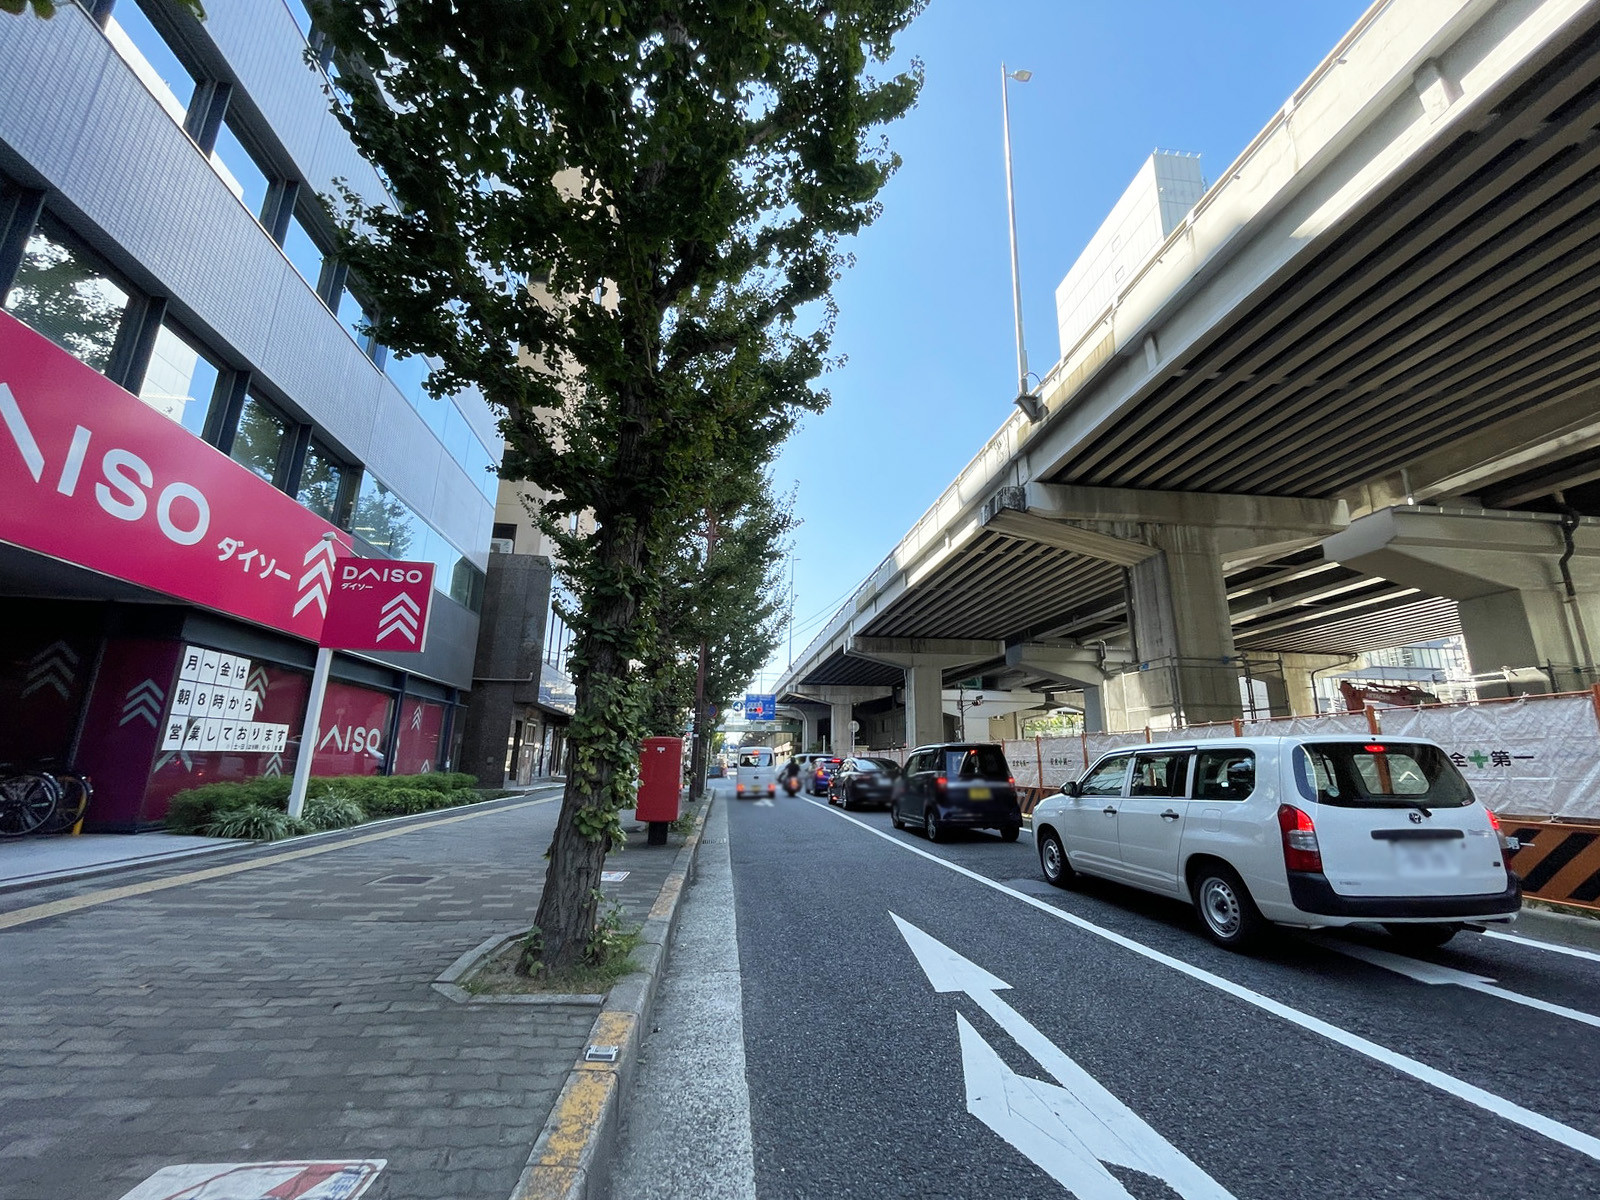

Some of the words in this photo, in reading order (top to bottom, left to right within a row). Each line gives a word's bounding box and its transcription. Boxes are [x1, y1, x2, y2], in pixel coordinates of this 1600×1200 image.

[217, 536, 292, 581] ダイソー
[342, 565, 423, 584] DAISO
[340, 582, 373, 591] ダイソー
[176, 688, 253, 712] 朝8時から
[168, 723, 286, 743] 営業しております
[314, 724, 381, 753] AISO
